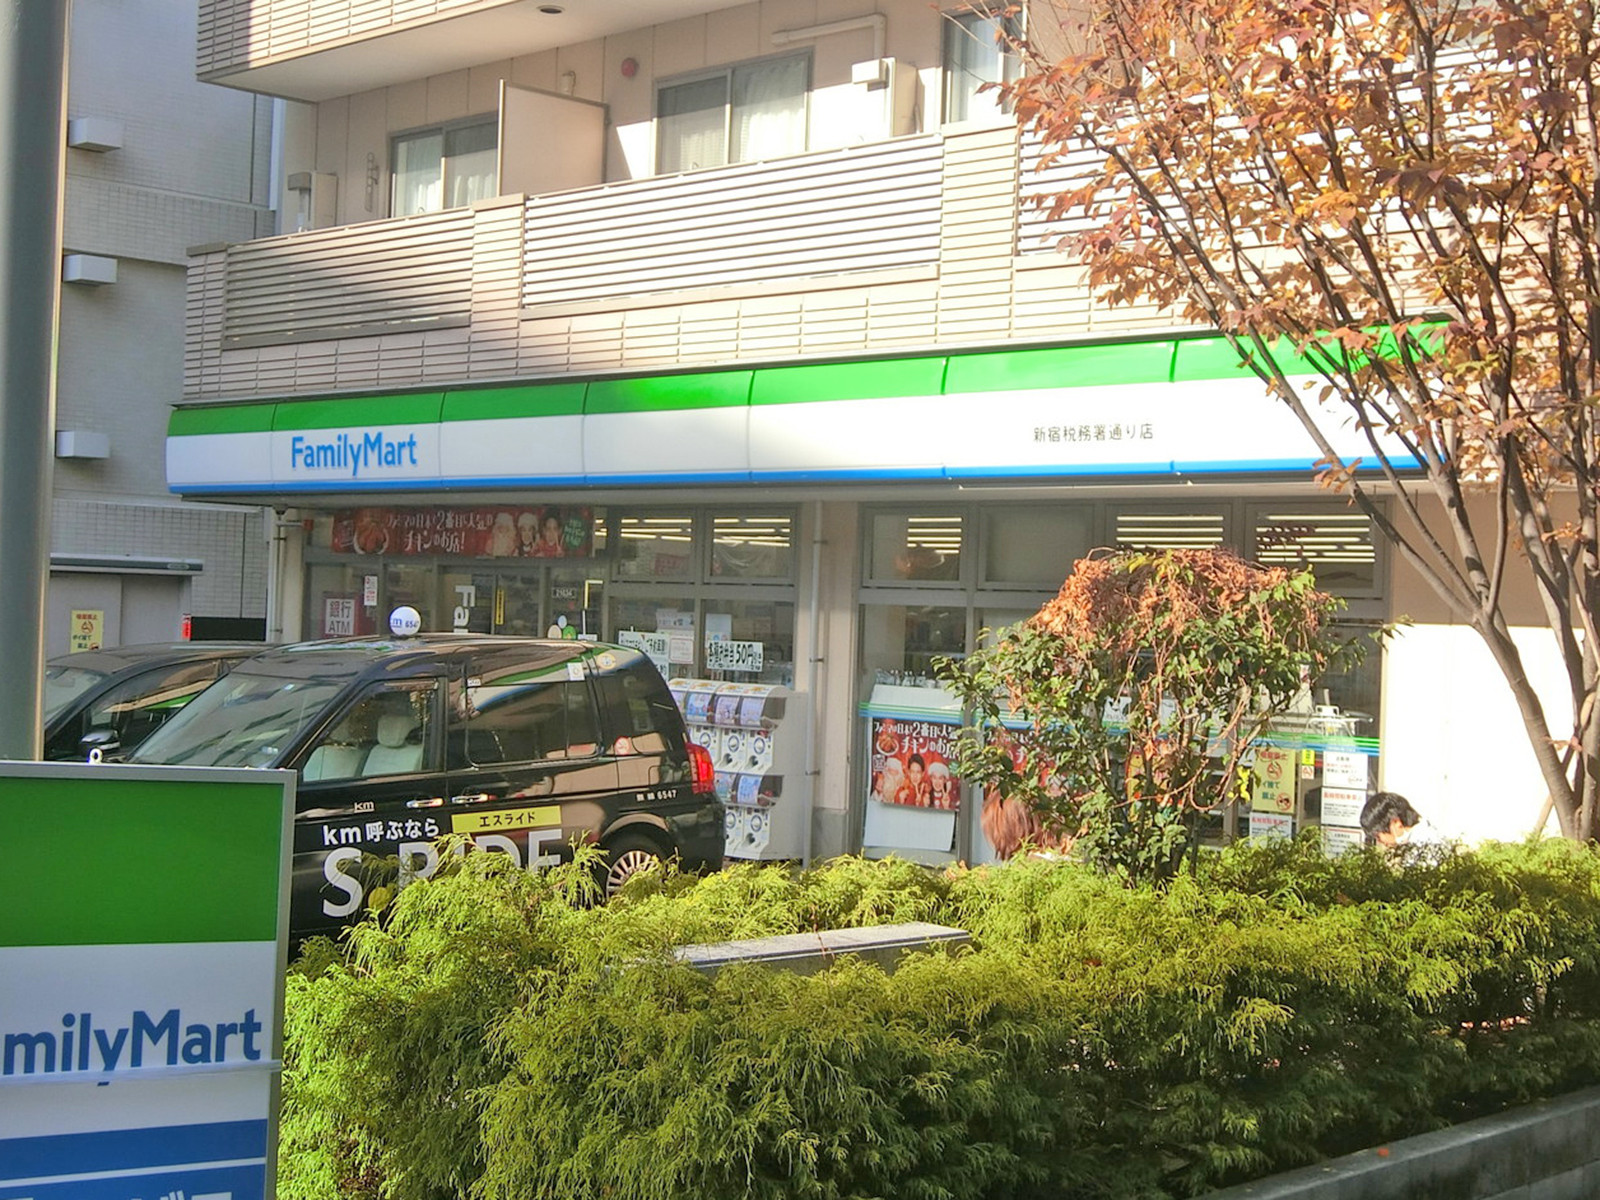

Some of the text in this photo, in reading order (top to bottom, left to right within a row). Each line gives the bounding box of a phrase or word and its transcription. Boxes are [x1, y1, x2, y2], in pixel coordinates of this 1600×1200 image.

[1033, 423, 1154, 441] 新宿税務署通り店
[291, 431, 417, 477] FamilyMart
[329, 600, 352, 618] 銀行
[453, 585, 476, 633] Fa
[328, 620, 351, 635] ATM
[657, 789, 678, 800] 6547
[354, 801, 375, 813] km
[479, 811, 536, 828] エスライド
[322, 818, 440, 846] km 呼ぶなら
